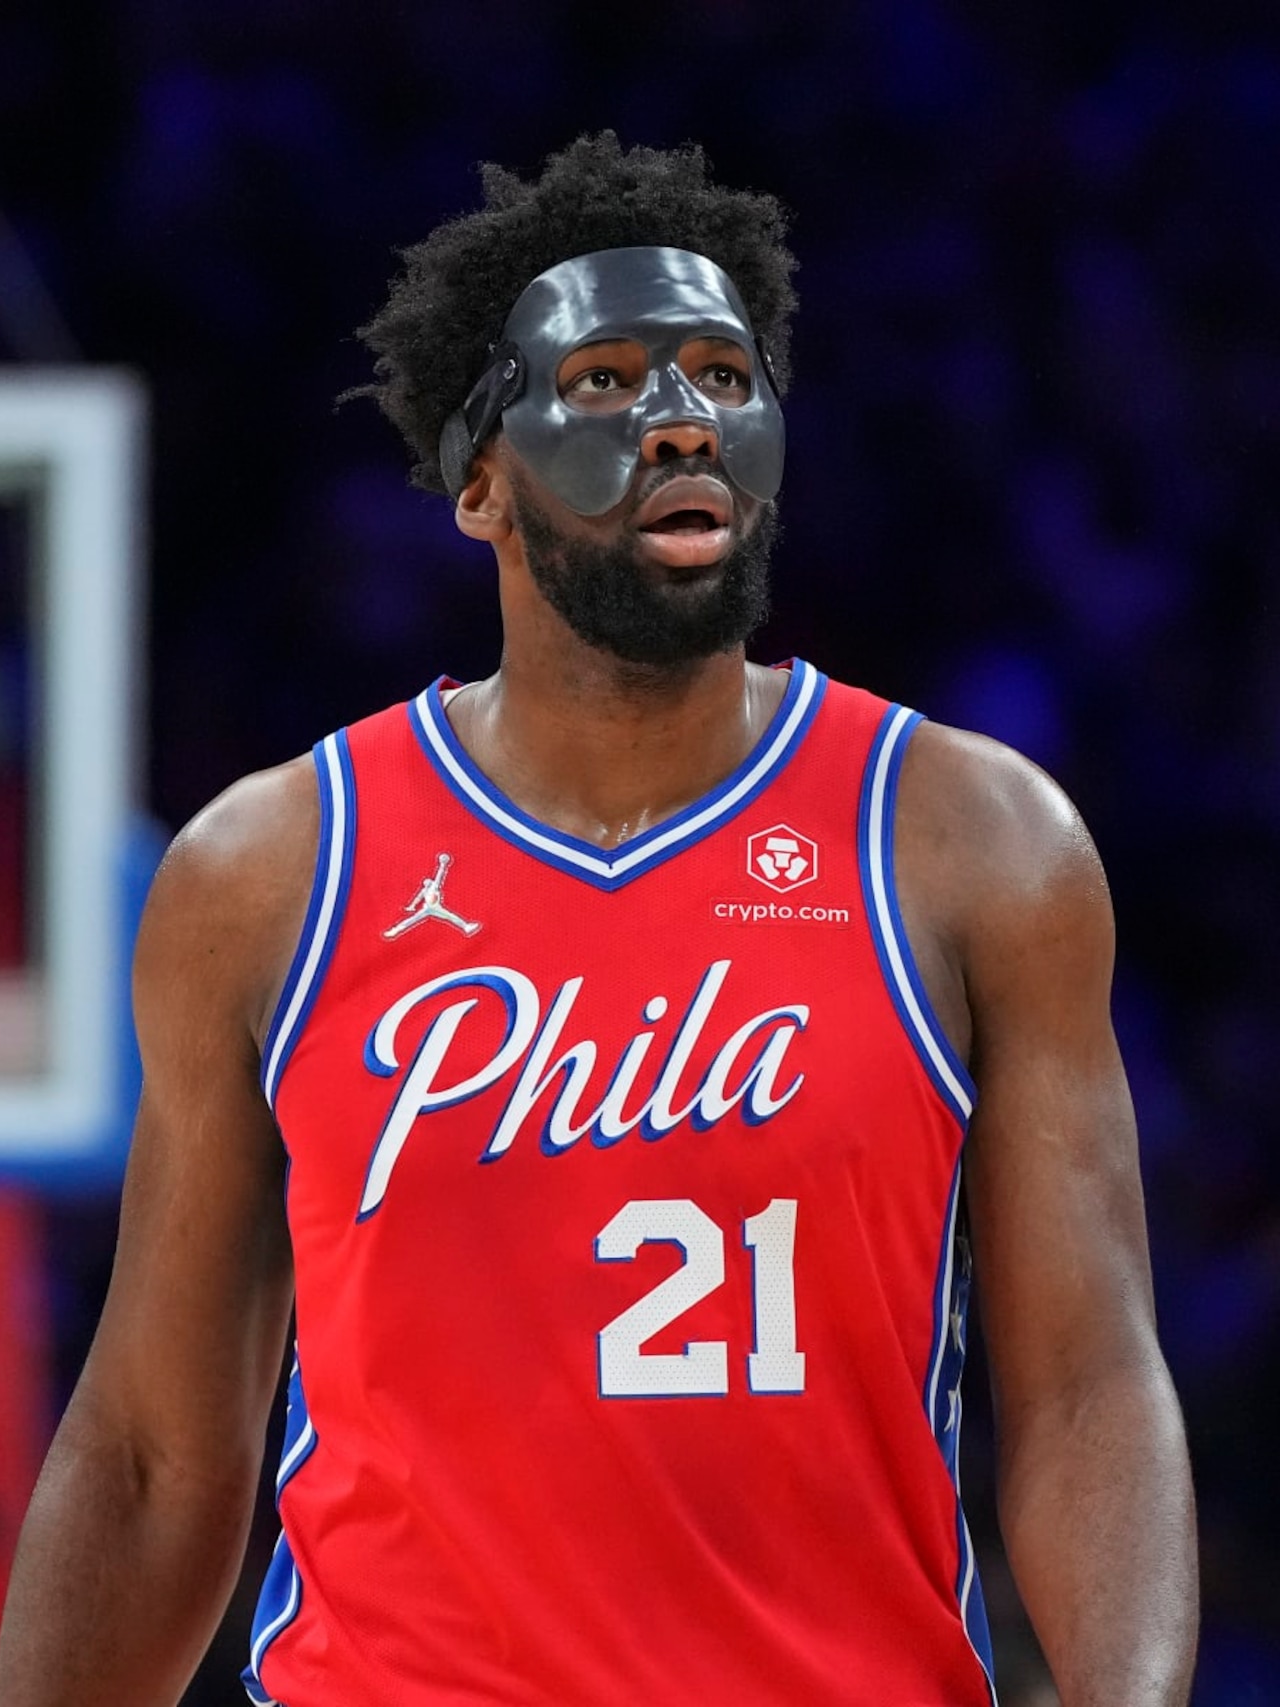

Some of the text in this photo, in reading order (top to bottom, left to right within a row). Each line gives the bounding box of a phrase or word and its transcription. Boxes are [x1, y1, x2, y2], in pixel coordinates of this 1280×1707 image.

[714, 902, 849, 923] crypto.com
[355, 959, 810, 1225] Phila
[594, 1198, 806, 1398] 21
